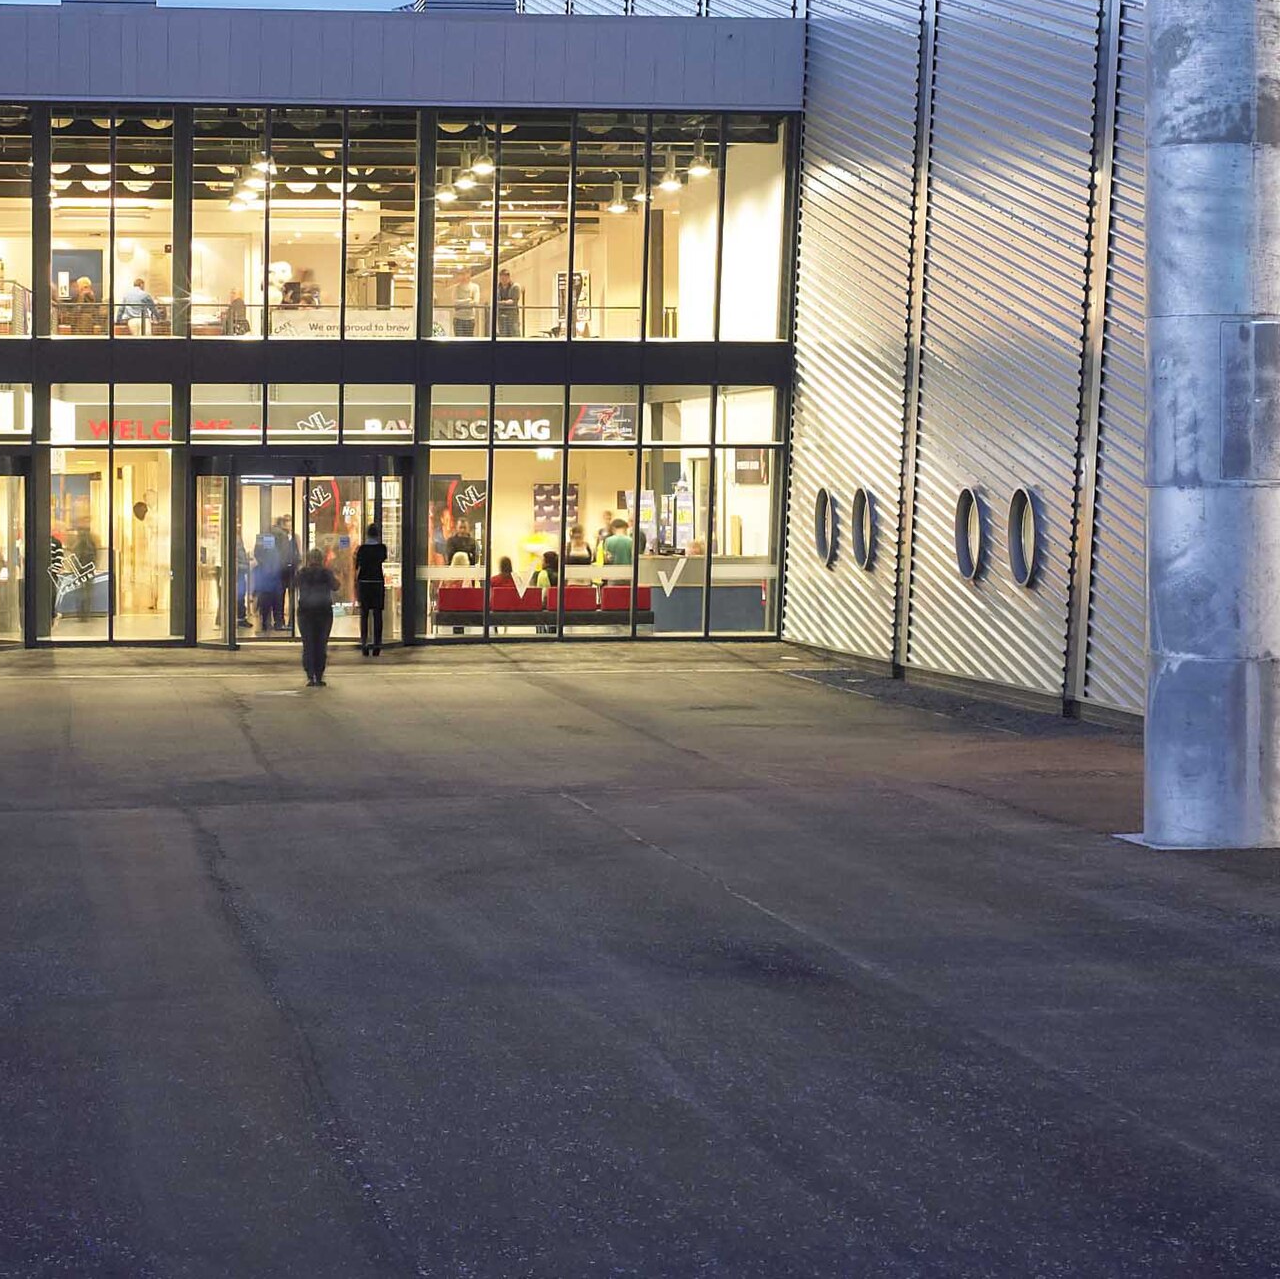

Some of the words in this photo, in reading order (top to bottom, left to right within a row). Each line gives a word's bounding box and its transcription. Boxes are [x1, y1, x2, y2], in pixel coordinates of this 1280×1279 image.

[309, 322, 324, 331] We
[374, 323, 384, 332] to
[386, 322, 410, 332] brew
[88, 418, 232, 441] WELCME
[455, 484, 487, 513] NL
